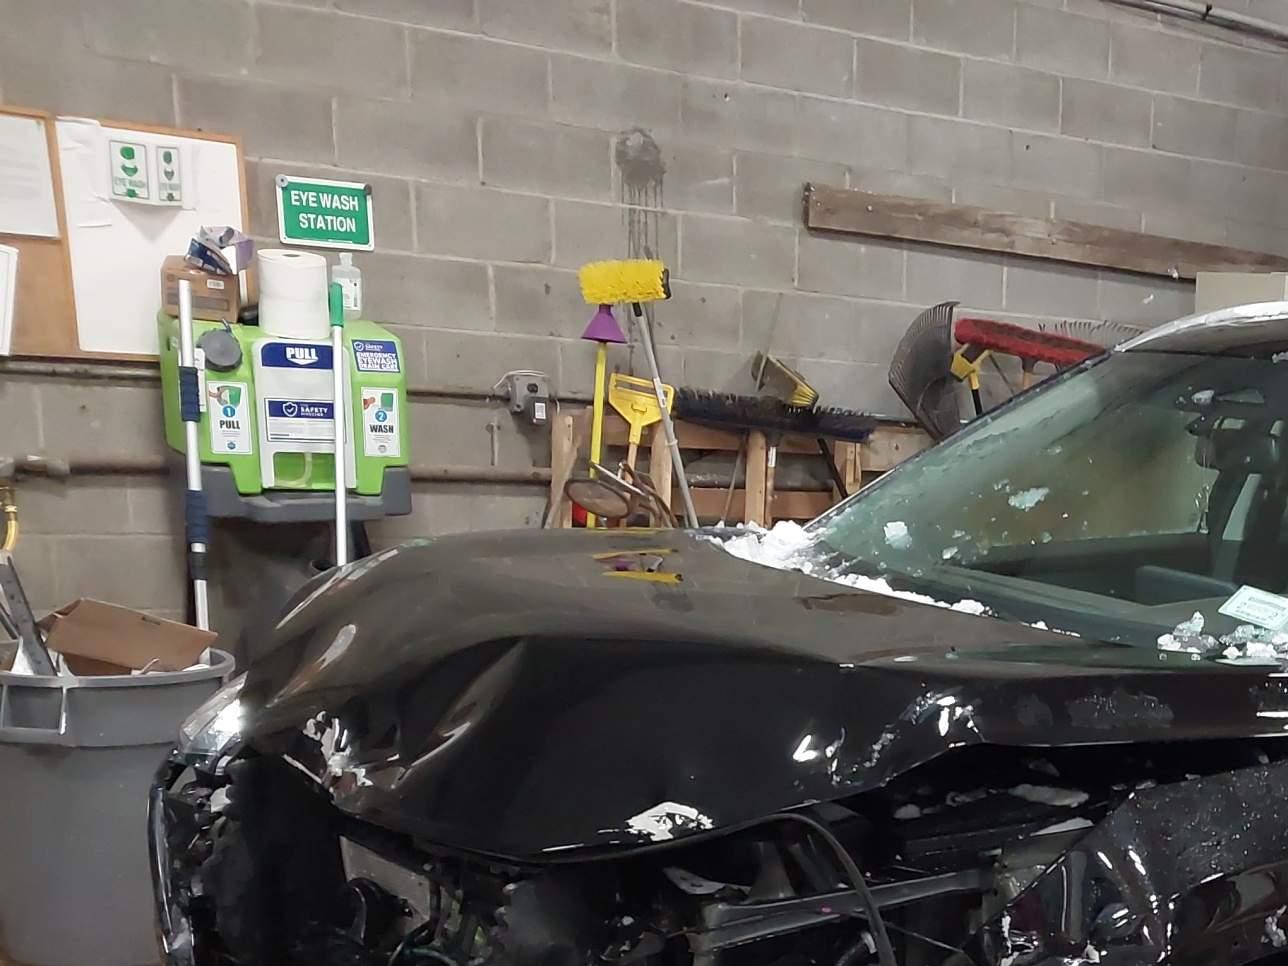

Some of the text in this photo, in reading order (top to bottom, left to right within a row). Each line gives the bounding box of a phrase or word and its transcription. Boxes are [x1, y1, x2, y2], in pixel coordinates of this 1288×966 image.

[290, 190, 359, 211] EYE WASH
[298, 213, 356, 232] STATION
[285, 347, 319, 360] PULL
[300, 406, 328, 414] SAFETY
[219, 420, 240, 429] PULL
[369, 424, 394, 433] WASH
